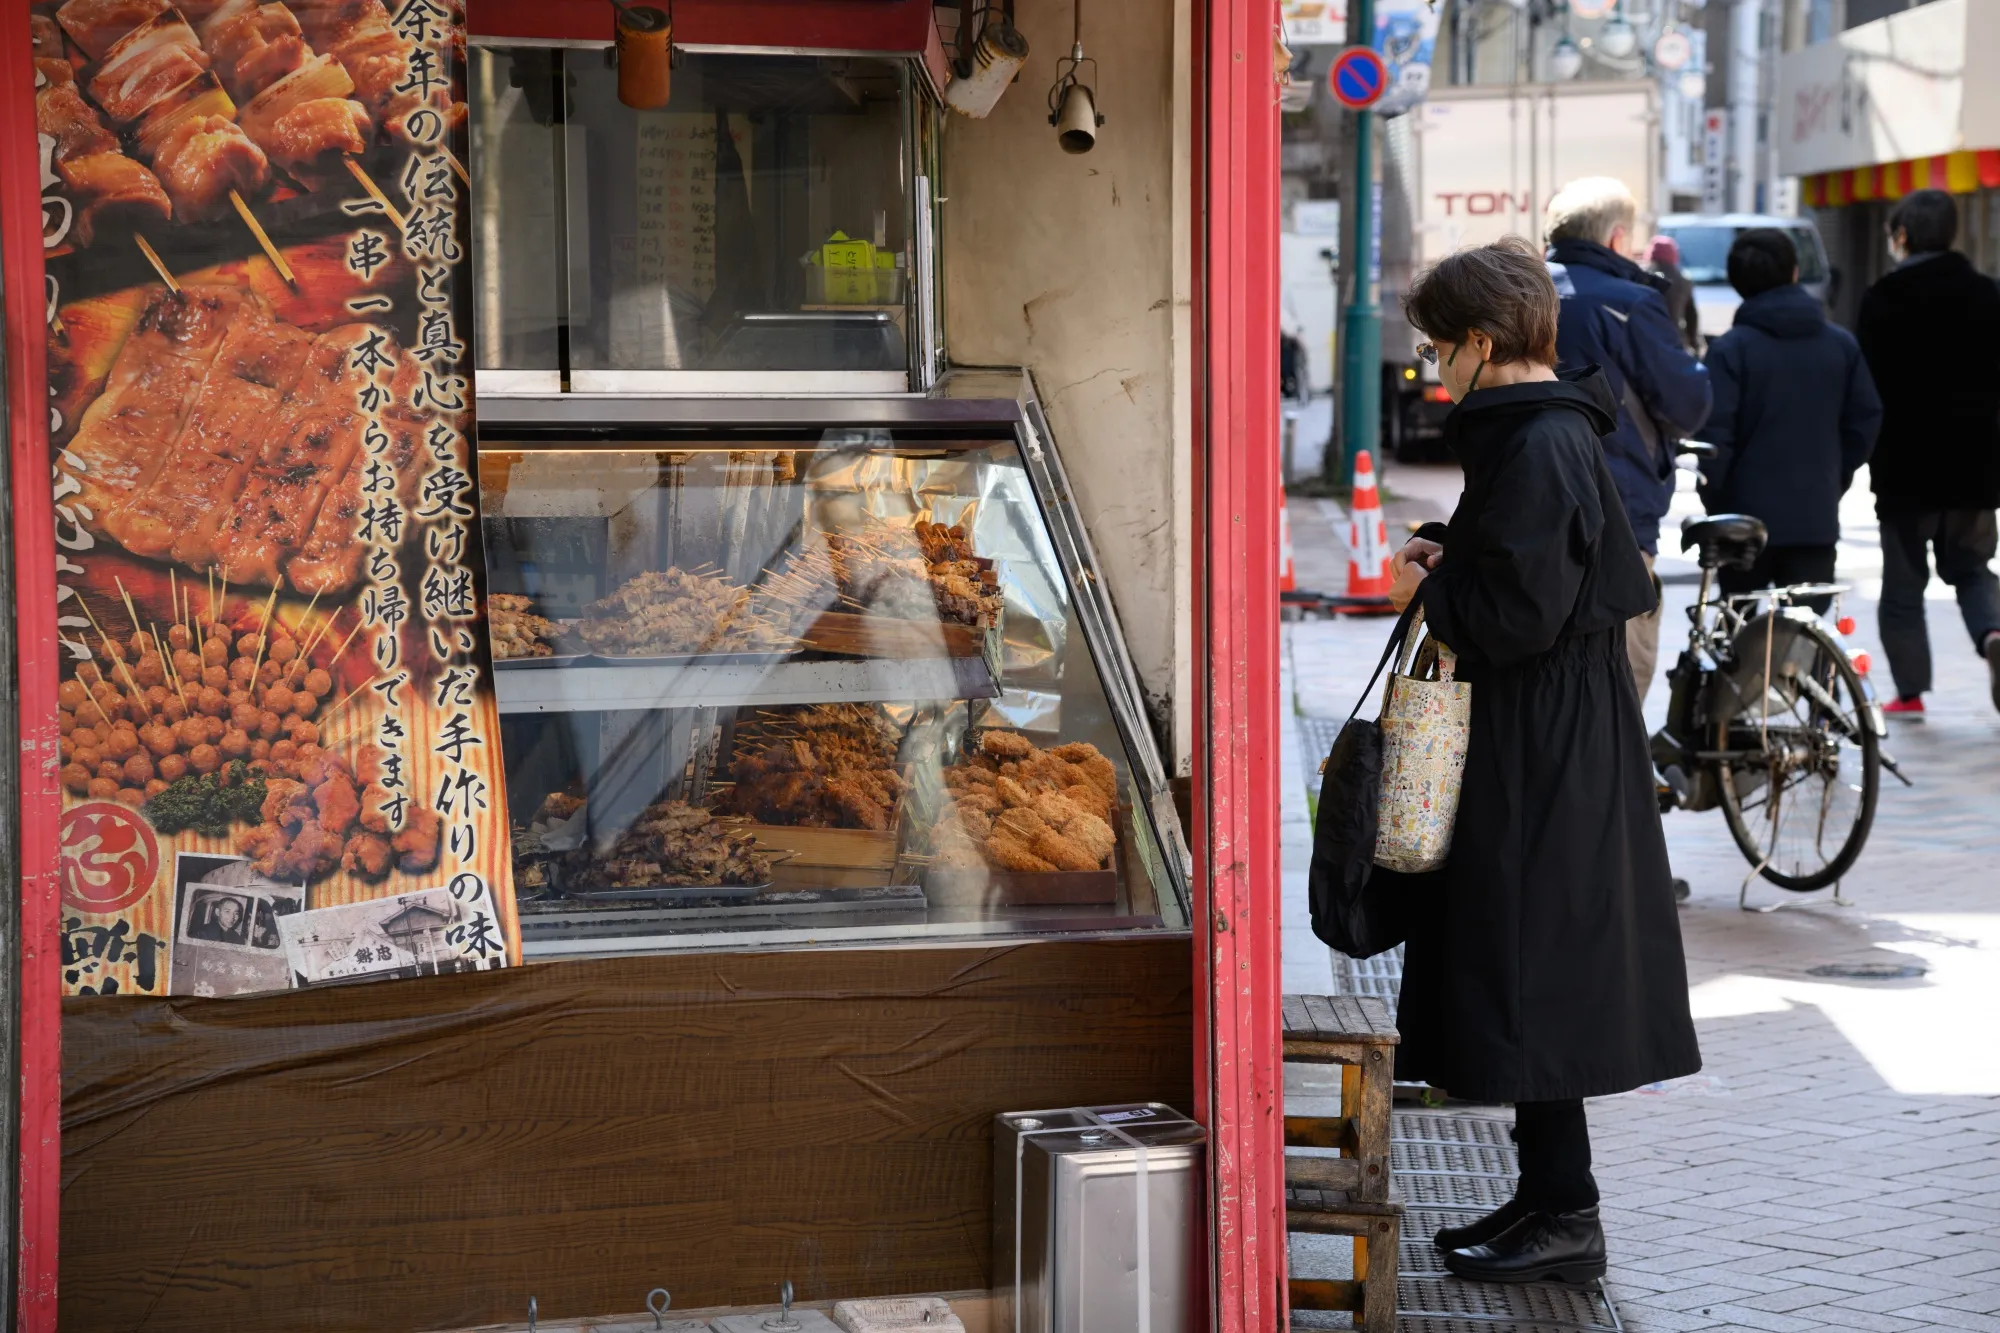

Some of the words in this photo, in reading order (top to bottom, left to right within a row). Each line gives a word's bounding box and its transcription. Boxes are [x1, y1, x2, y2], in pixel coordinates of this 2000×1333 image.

[344, 199, 411, 828] 一串一本からお持ち帰りできます
